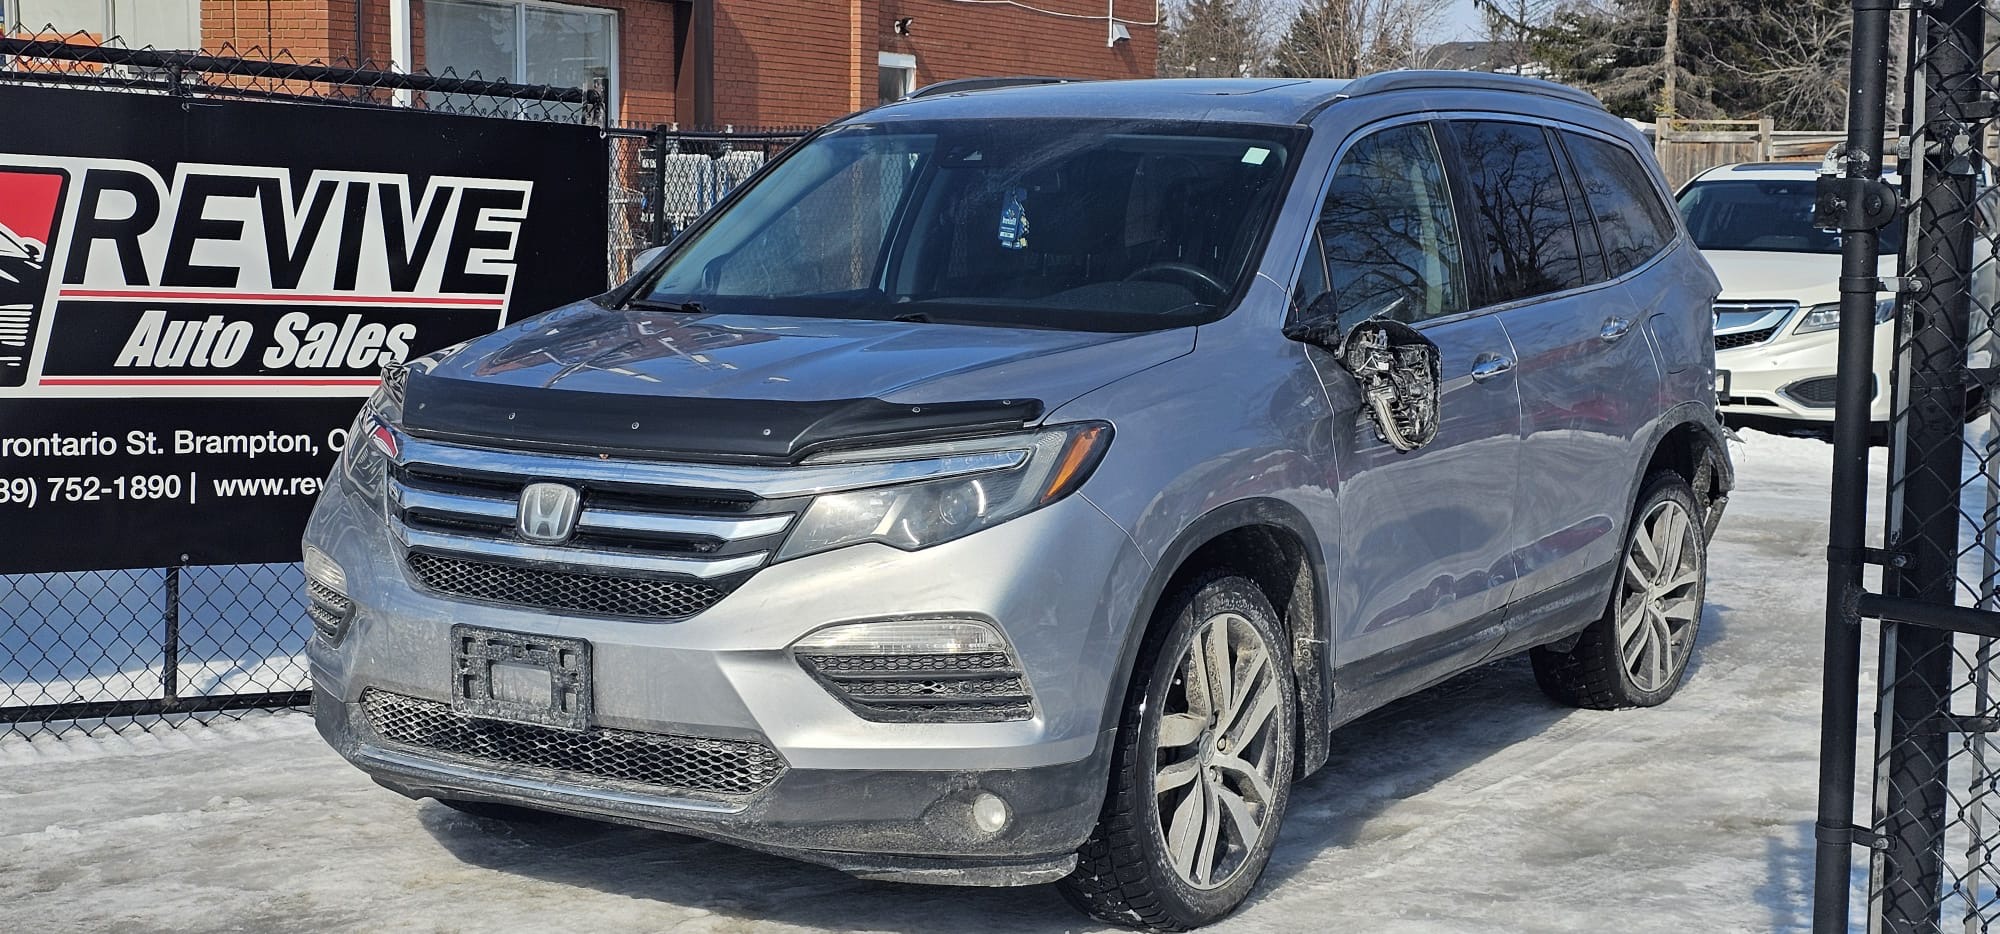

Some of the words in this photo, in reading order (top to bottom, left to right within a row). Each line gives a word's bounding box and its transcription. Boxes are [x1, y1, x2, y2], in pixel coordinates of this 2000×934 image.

[62, 166, 528, 296] REVIVE
[113, 309, 254, 368] Auto
[262, 311, 418, 369] Sales
[126, 430, 164, 455] St.
[174, 429, 319, 459] Brampton,
[47, 474, 182, 502] 752-1890
